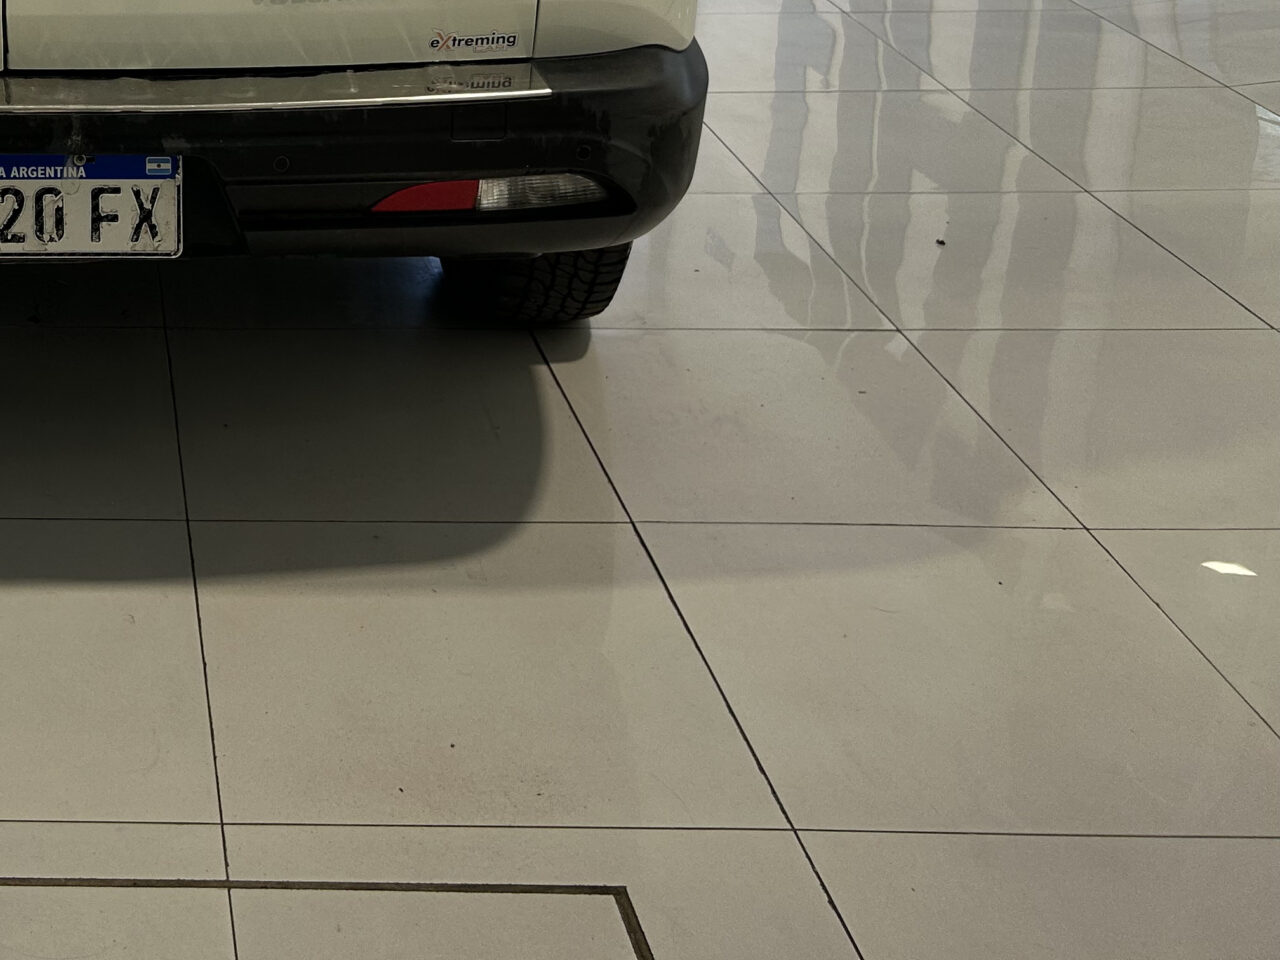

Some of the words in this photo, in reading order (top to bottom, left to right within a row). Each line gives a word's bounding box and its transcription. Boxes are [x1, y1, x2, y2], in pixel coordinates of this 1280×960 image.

[429, 28, 518, 52] eXtreming
[9, 166, 87, 179] ARGENTINA
[89, 186, 161, 244] FX
